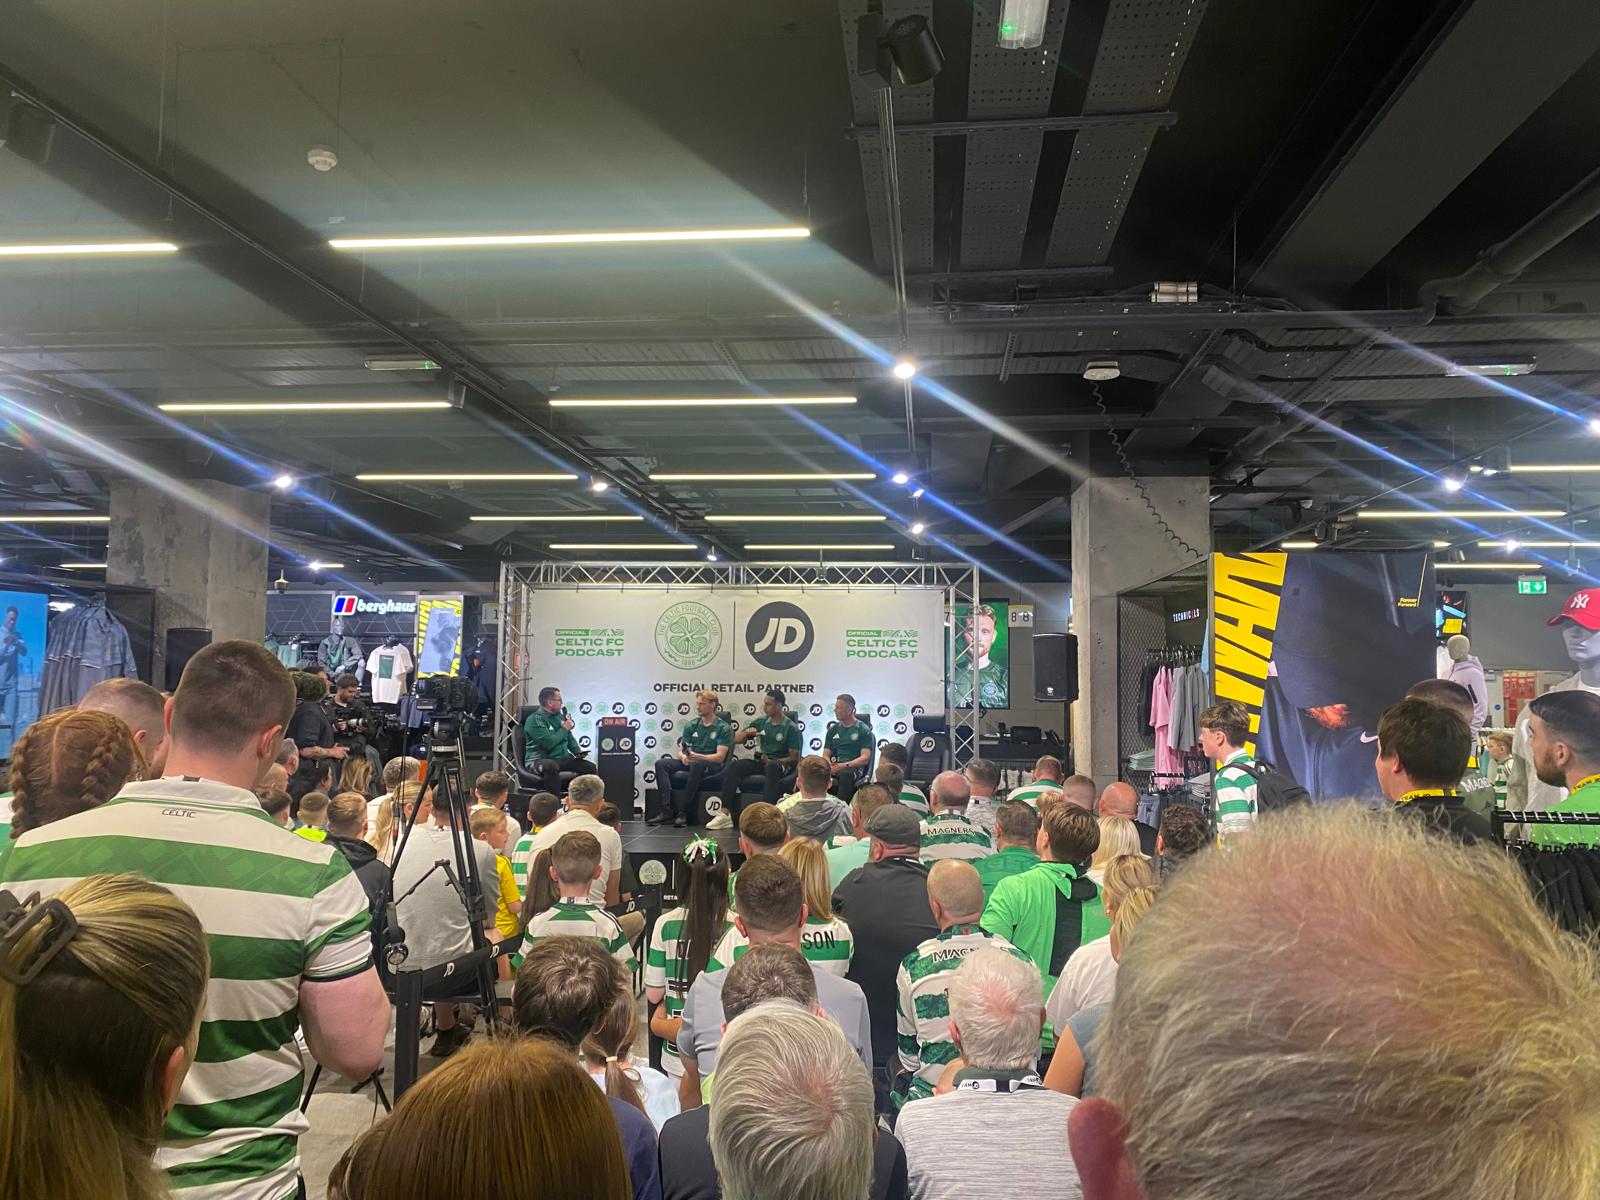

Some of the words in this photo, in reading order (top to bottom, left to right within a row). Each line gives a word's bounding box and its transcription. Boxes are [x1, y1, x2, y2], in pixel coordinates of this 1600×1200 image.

[357, 599, 416, 615] berghaus
[754, 618, 806, 653] JD
[556, 638, 603, 646] CELTIC
[606, 638, 624, 646] FC
[847, 639, 896, 647] CELTIC
[899, 639, 918, 647] FC
[847, 650, 918, 658] PODCAST
[711, 683, 753, 693] RETAIL
[922, 740, 934, 748] JD
[707, 802, 720, 811] JD
[162, 809, 198, 818] CELTIC
[927, 827, 976, 836] MAGNERS
[626, 901, 635, 912] JD
[489, 945, 500, 959] JD
[443, 962, 455, 978] JD
